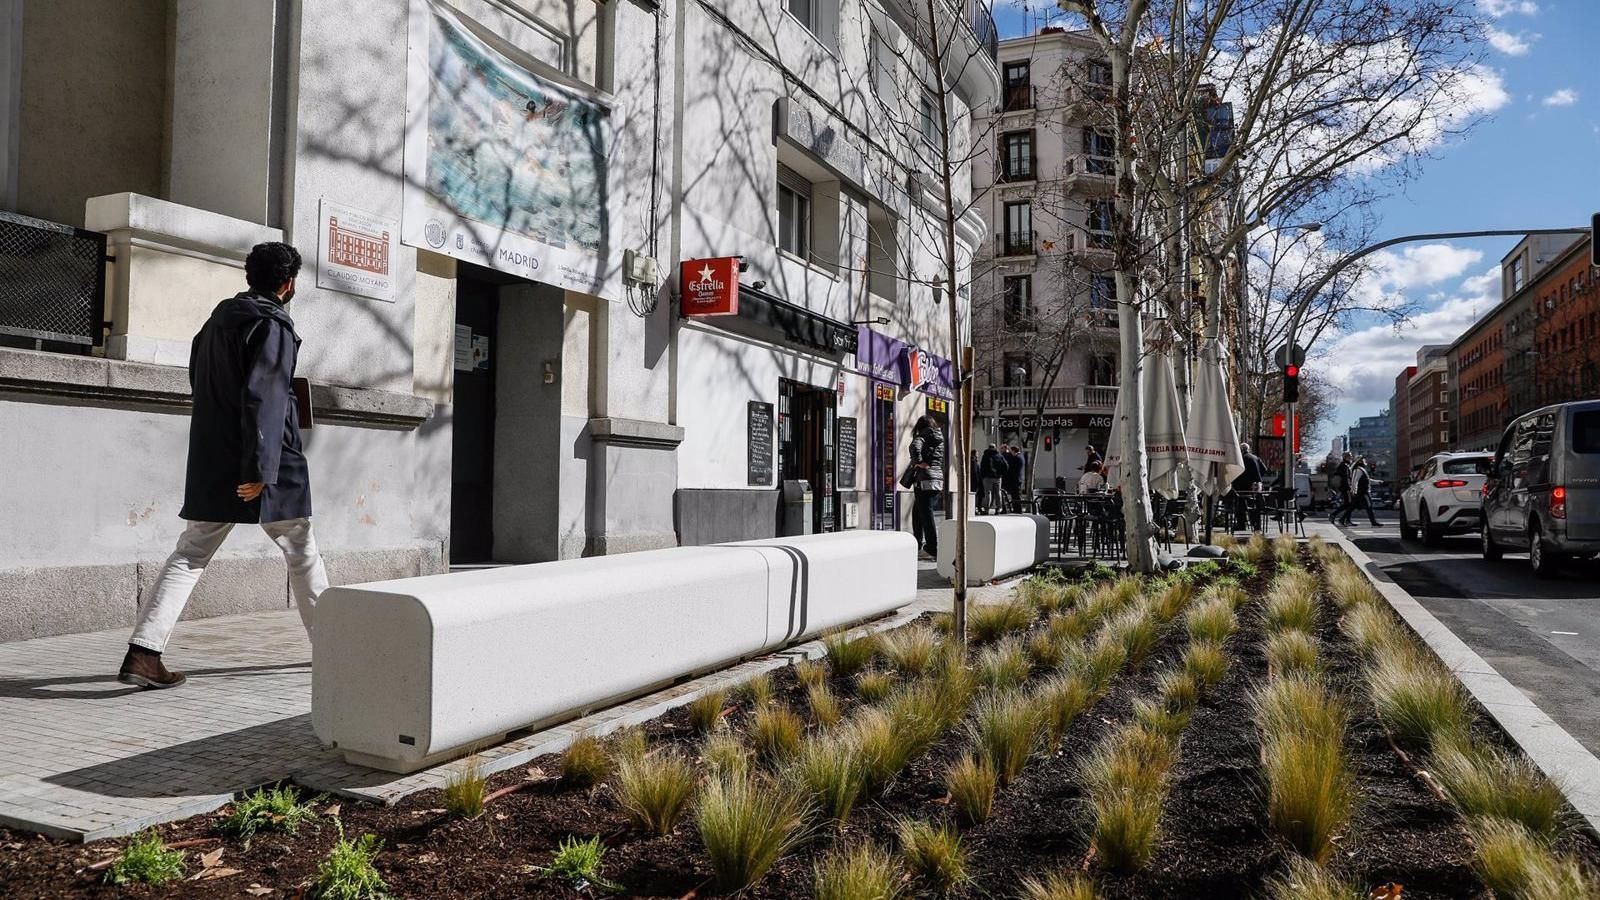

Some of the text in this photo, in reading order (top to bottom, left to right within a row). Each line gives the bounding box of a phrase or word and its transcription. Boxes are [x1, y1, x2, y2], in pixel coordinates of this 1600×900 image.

[499, 248, 539, 269] MADRID
[328, 269, 389, 289] CLAUDIO MOYANO
[688, 280, 724, 291] Estrella
[999, 418, 1019, 428] cas
[1089, 417, 1112, 428] ARG
